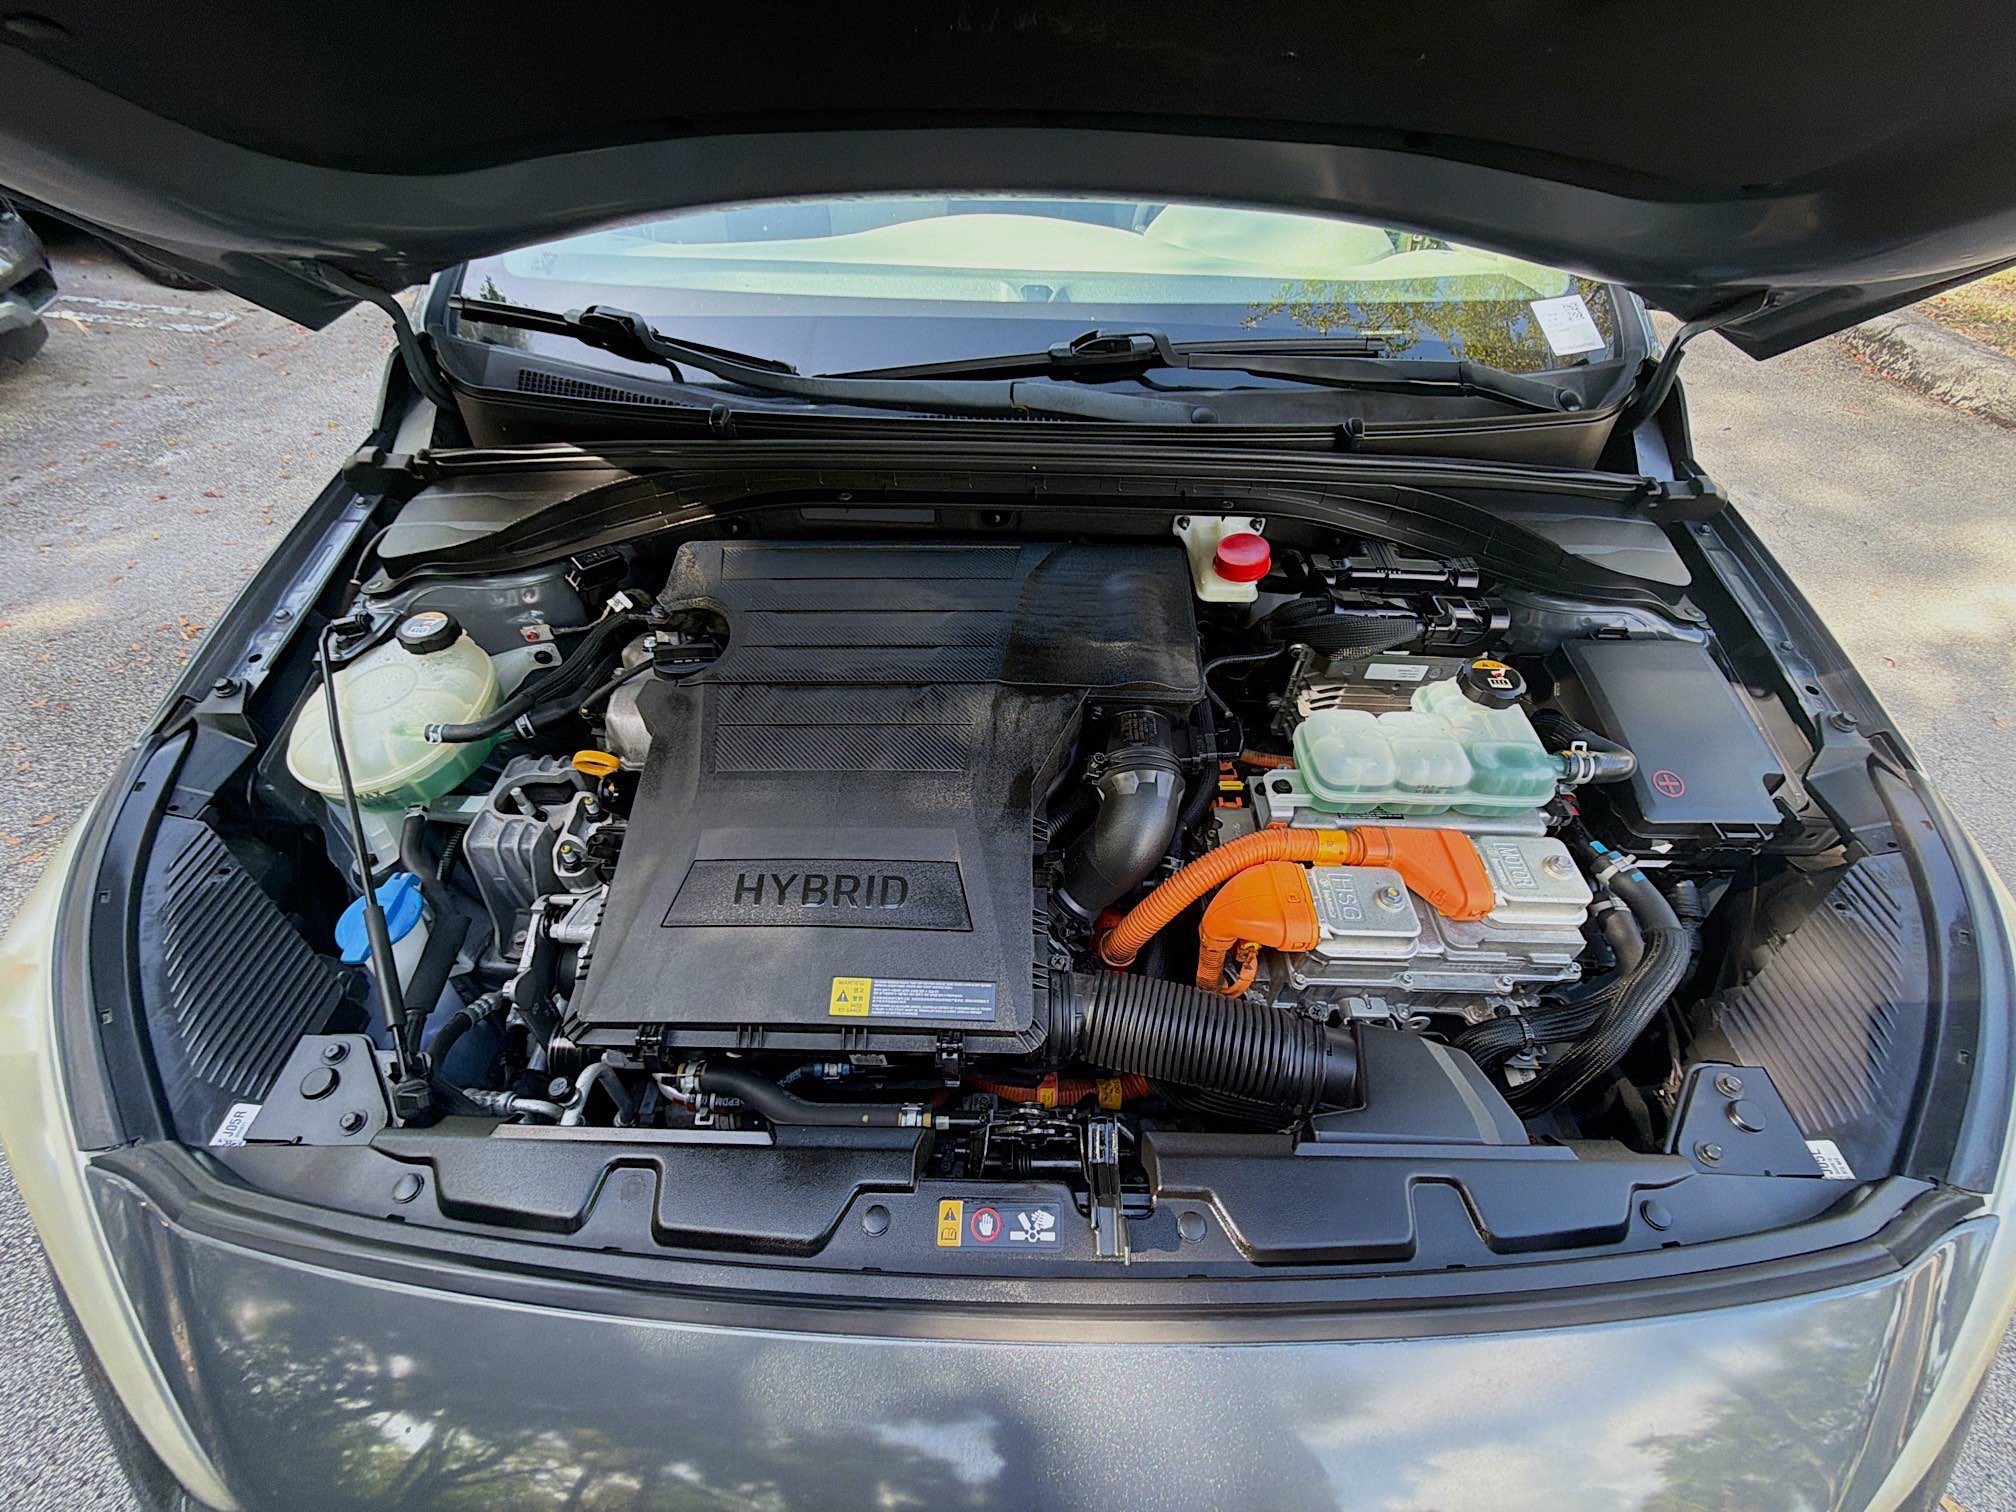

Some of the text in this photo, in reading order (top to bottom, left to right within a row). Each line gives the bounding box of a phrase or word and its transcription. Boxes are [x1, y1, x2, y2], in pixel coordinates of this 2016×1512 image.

[1498, 847, 1534, 887] MOTOR
[732, 873, 910, 909] HYBRID
[1331, 878, 1362, 920] HSG
[715, 1097, 740, 1106] EPDM
[222, 1110, 247, 1138] J05R
